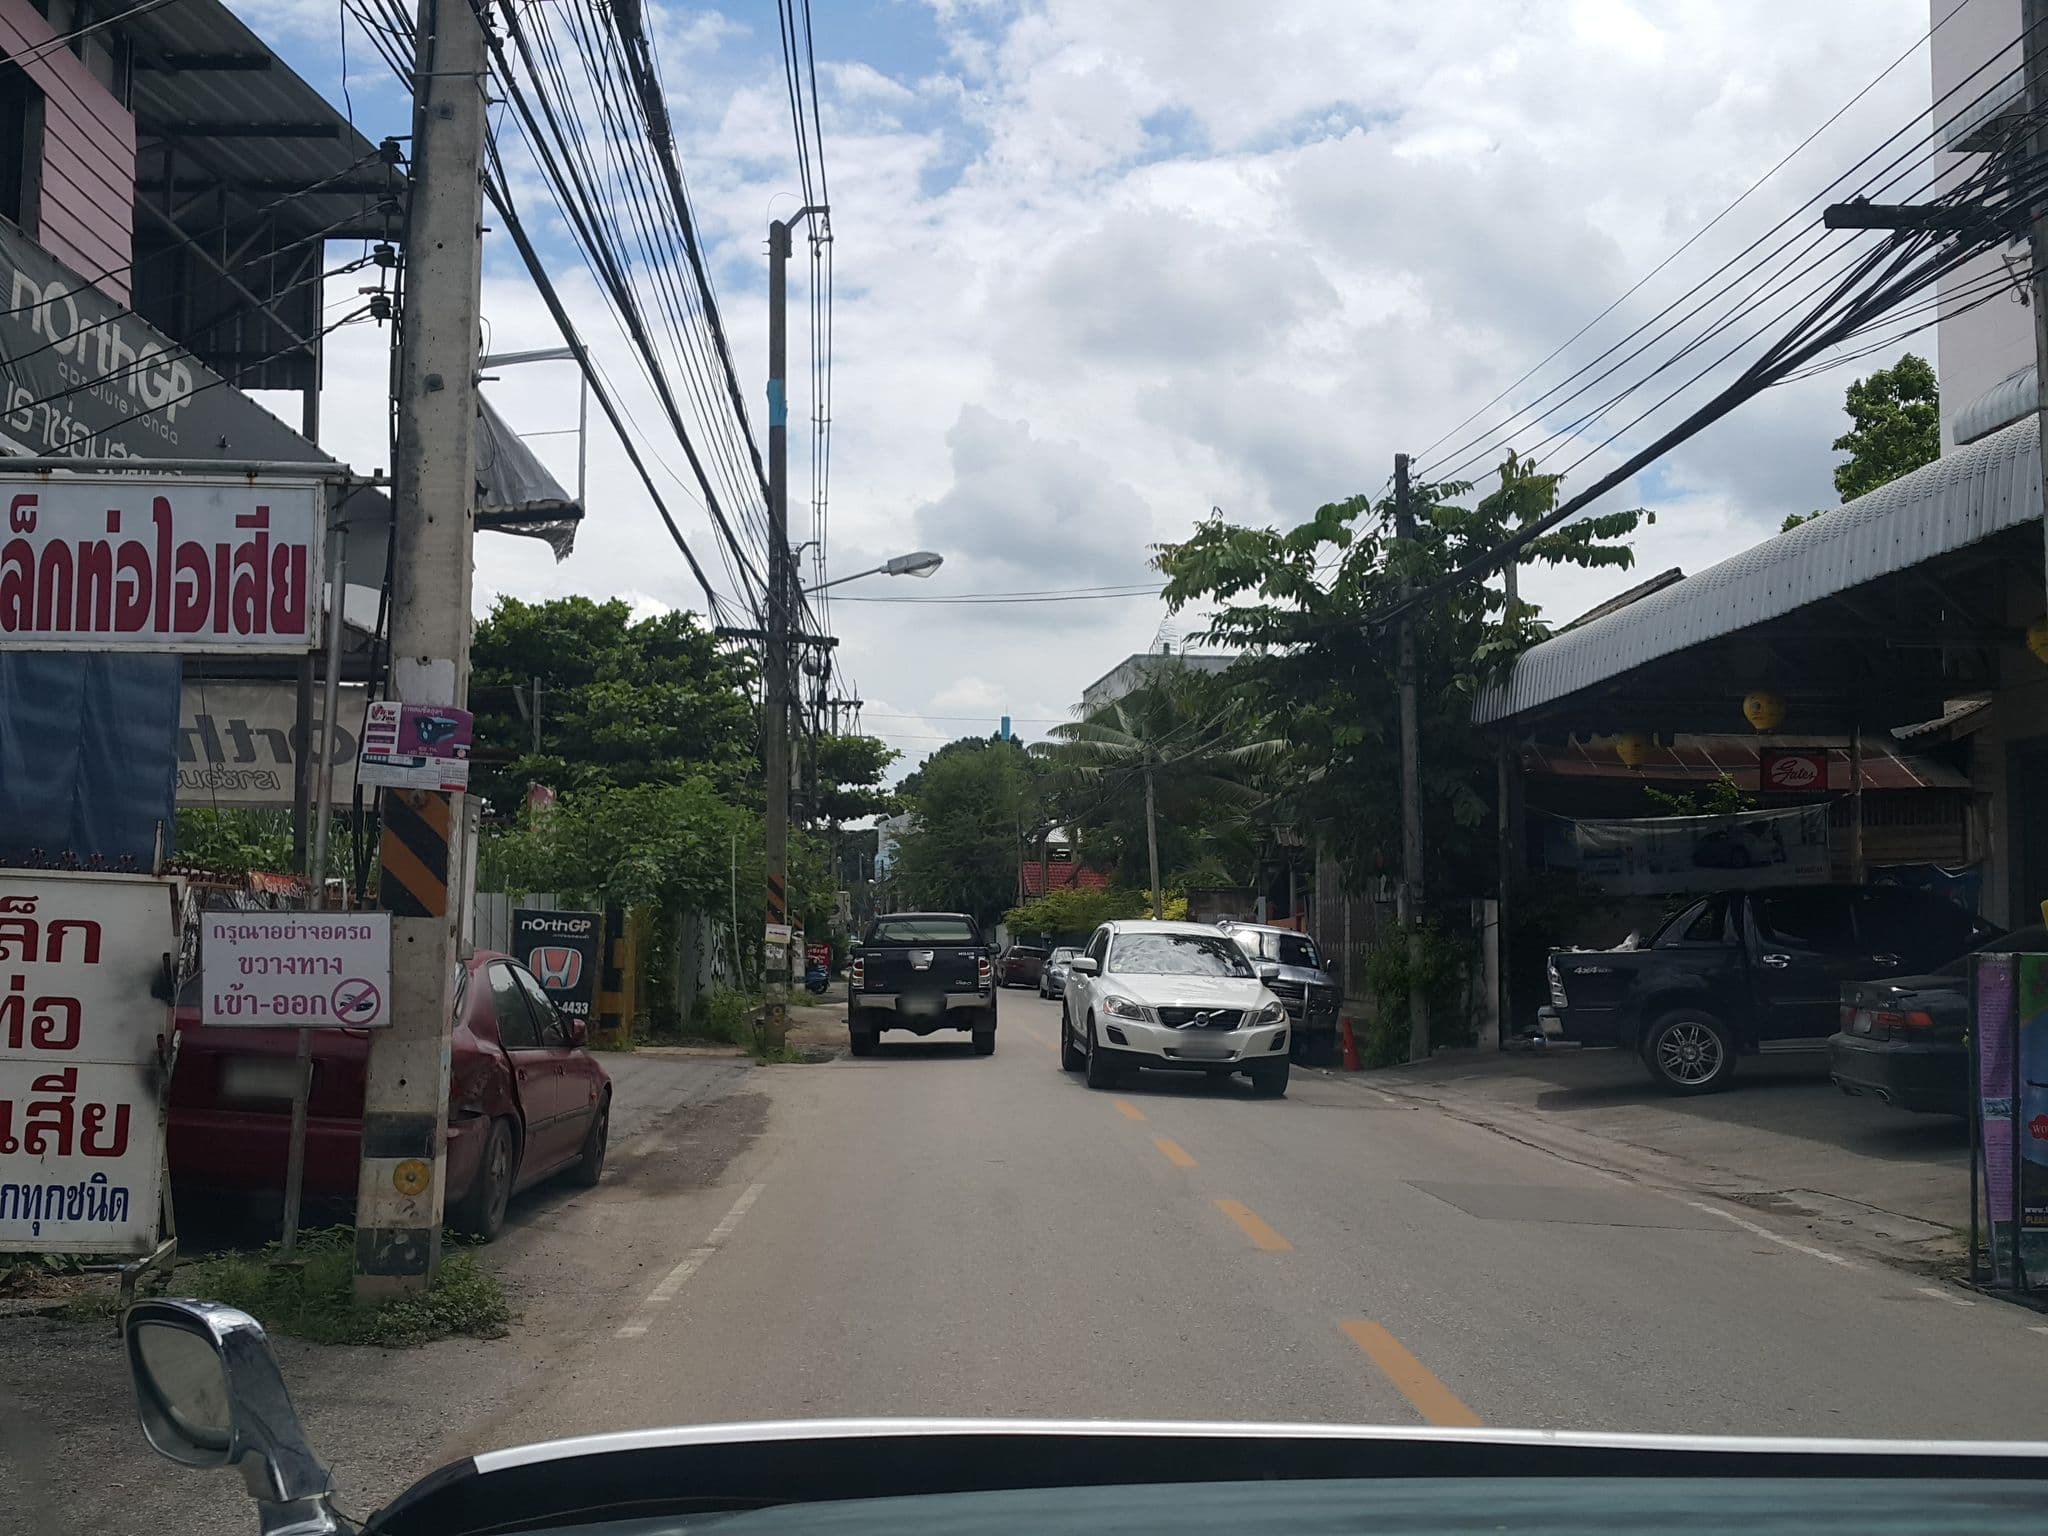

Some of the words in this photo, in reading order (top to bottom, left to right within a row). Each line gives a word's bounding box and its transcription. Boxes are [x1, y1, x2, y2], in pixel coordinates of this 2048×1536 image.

[213, 921, 372, 946] กรุณาอย่าจอดรถ
[521, 918, 592, 933] nOrthGP
[238, 956, 343, 976] ขวางทาง
[213, 983, 328, 1016] เข้า-ออก
[554, 1001, 589, 1015] -4433
